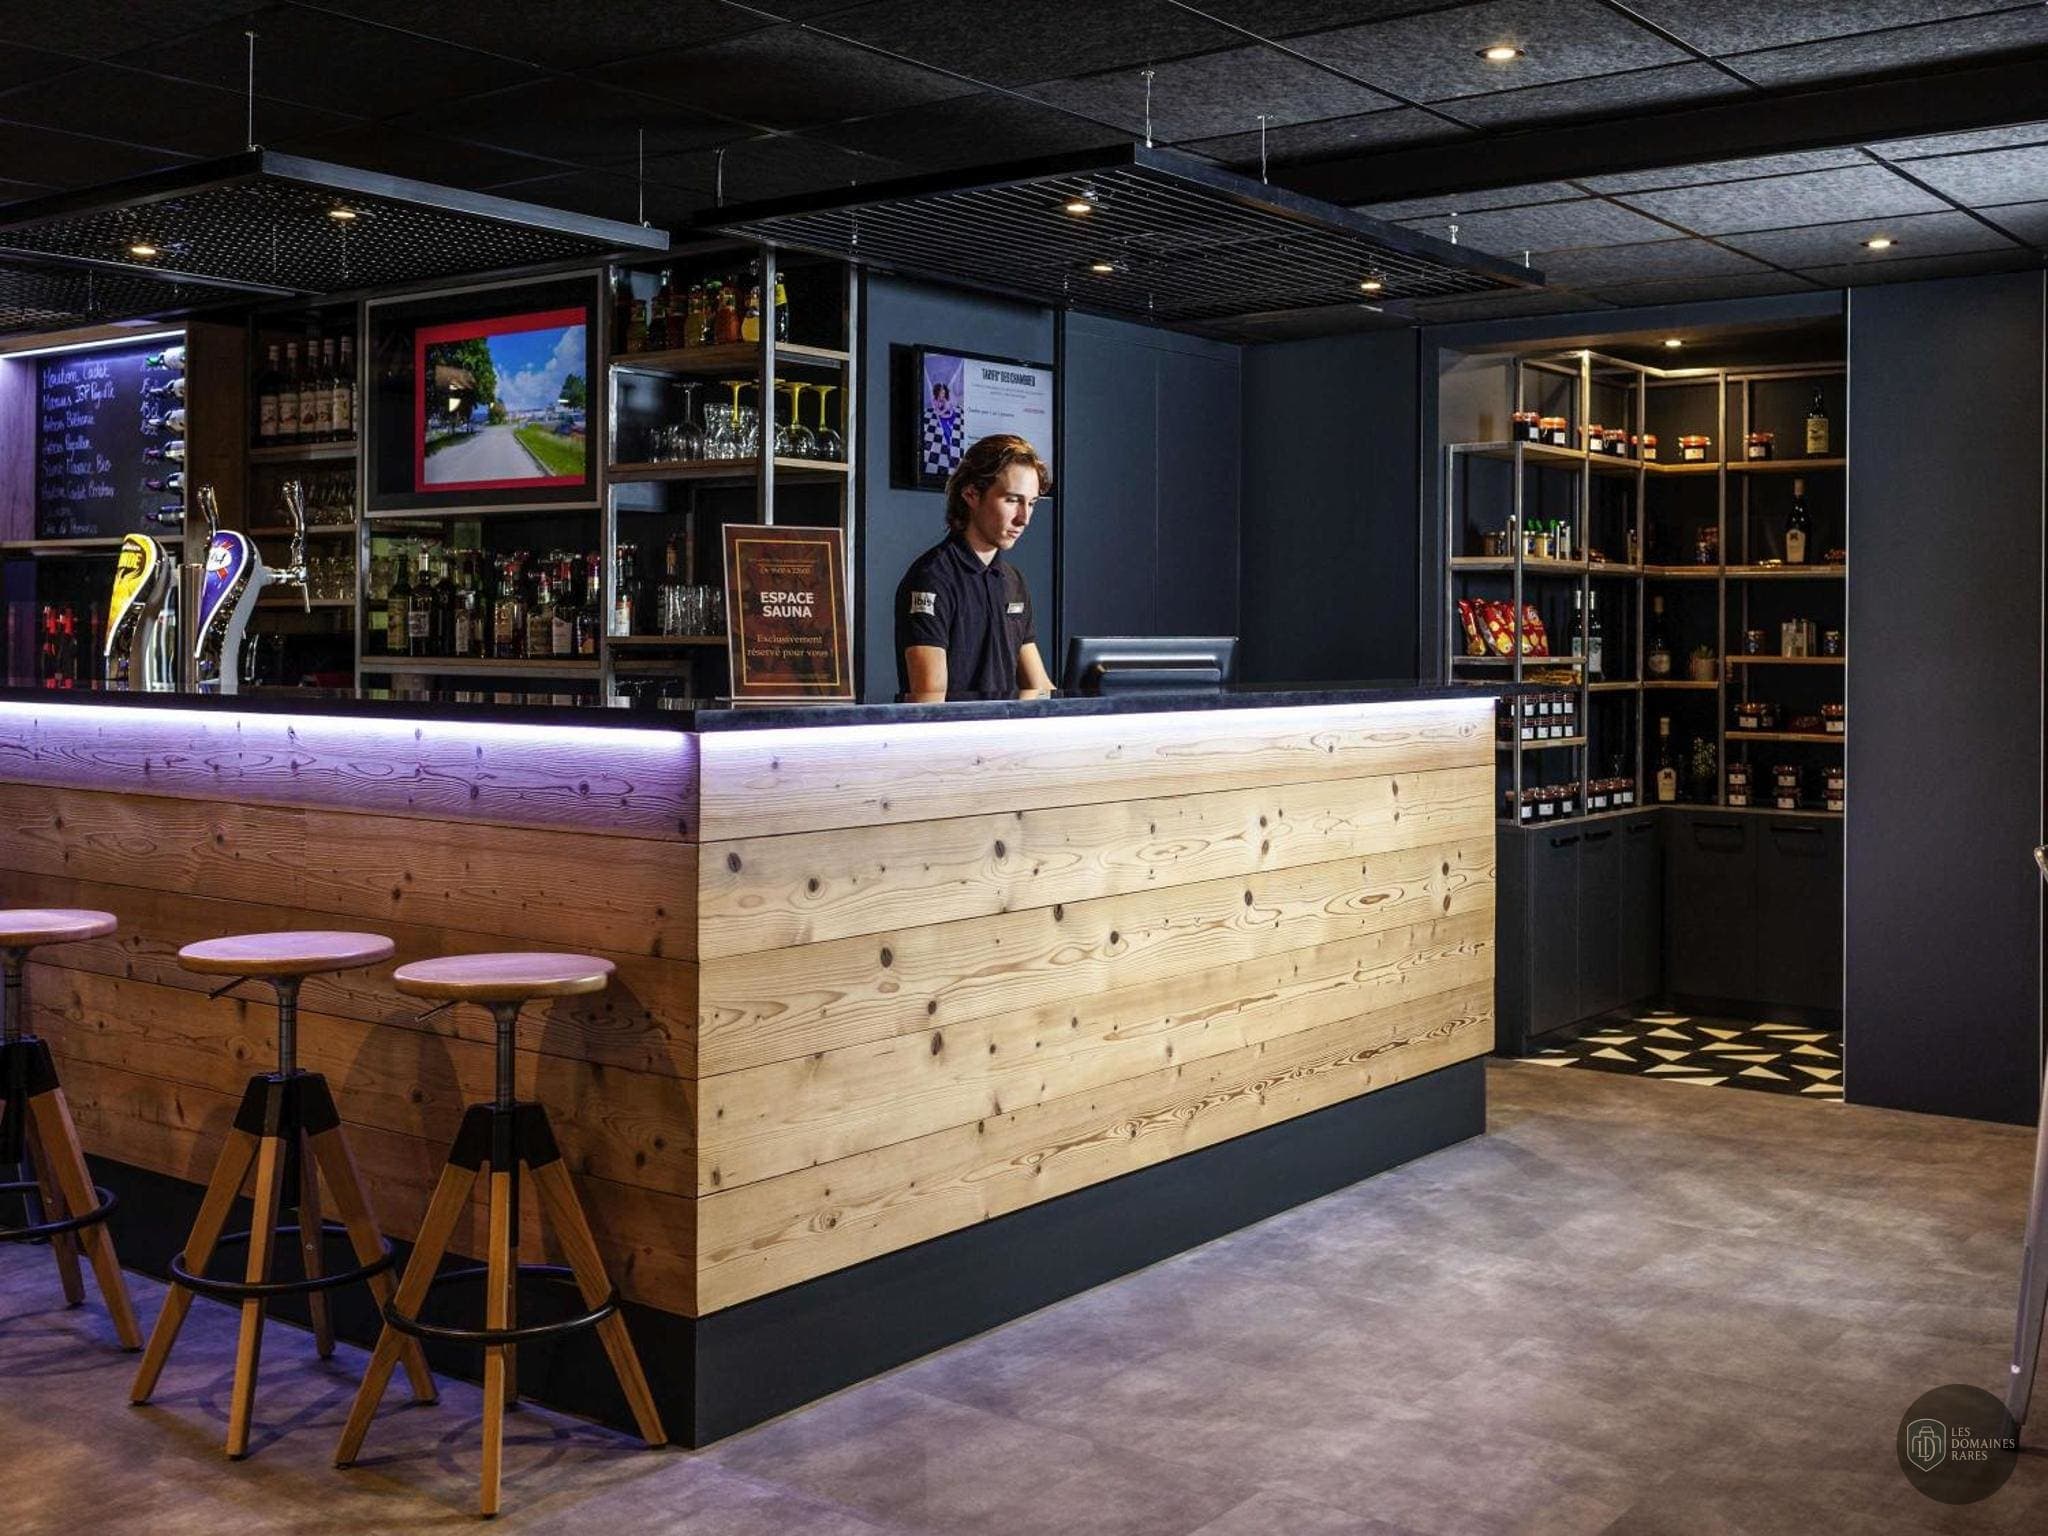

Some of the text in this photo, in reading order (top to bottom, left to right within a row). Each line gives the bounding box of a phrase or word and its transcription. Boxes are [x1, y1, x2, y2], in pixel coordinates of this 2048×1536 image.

[760, 591, 815, 605] ESPACE
[762, 605, 813, 618] SAUNA
[757, 633, 823, 644] Exclusivement
[783, 649, 805, 659] pour
